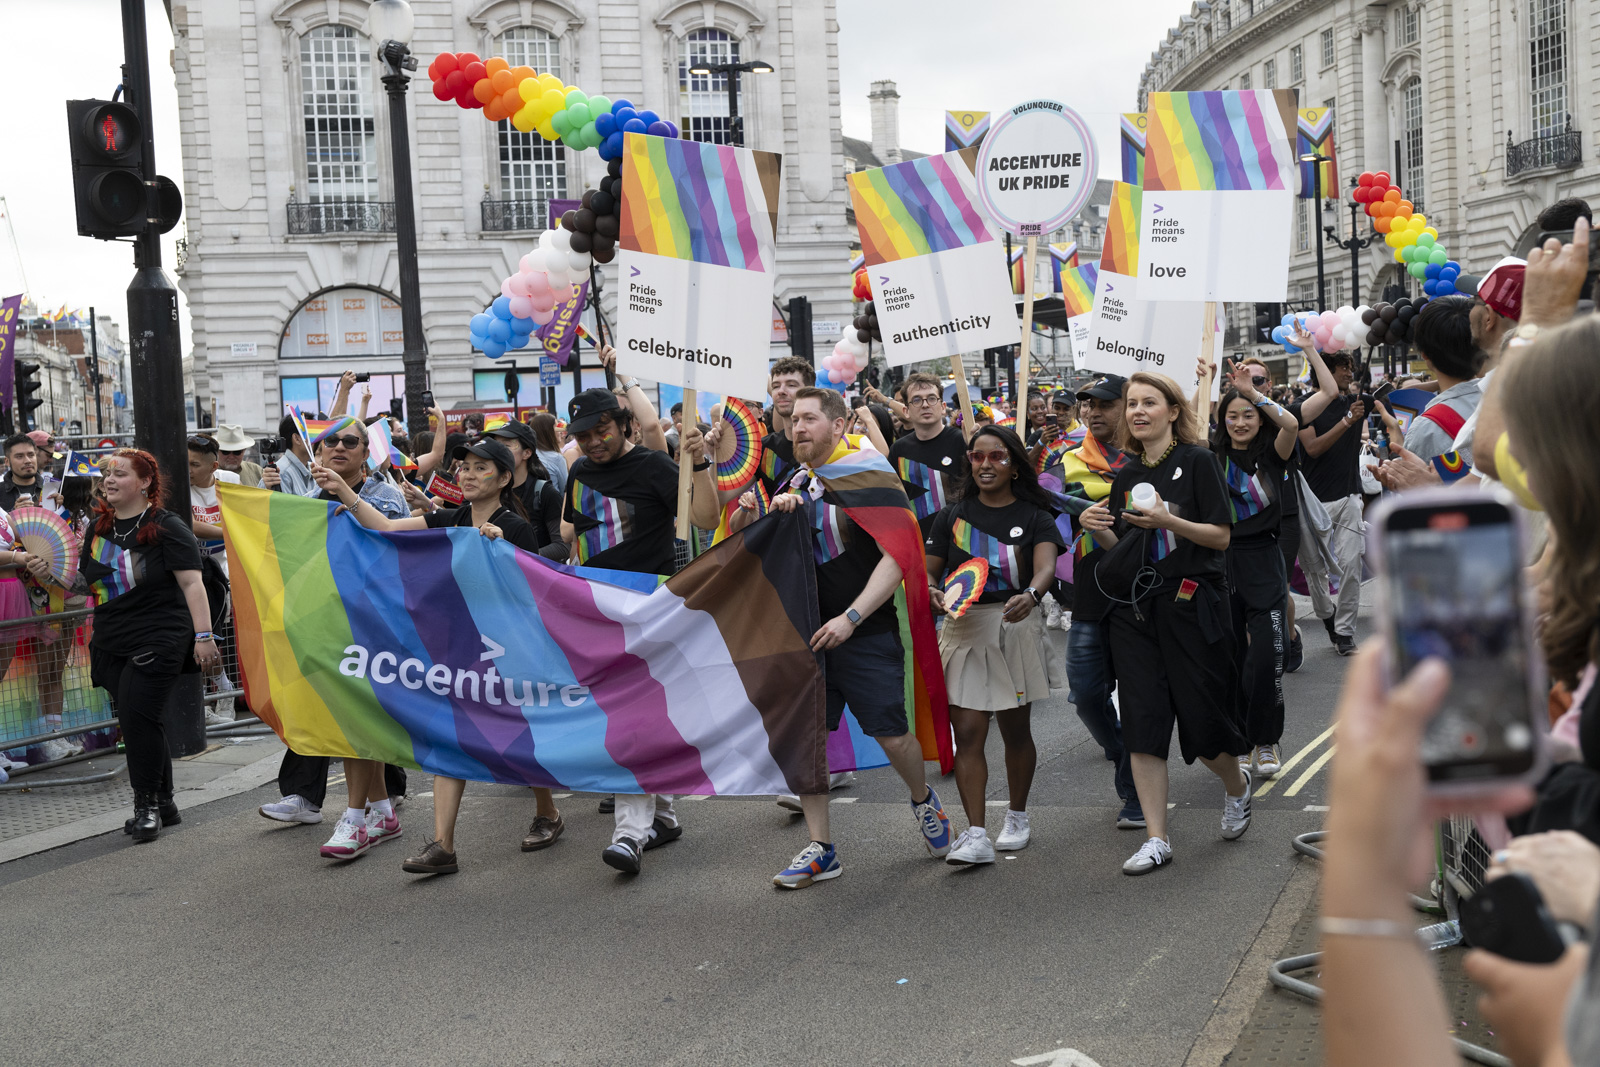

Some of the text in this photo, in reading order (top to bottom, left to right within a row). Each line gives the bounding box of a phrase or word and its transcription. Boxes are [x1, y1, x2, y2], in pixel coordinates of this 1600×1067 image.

[1012, 101, 1063, 116] VOLUNQUEER
[989, 152, 1082, 171] ACCENTURE
[998, 174, 1070, 191] UK PRIDE
[1152, 218, 1179, 226] Pride
[1149, 262, 1187, 278] love
[630, 283, 656, 296] Pride
[883, 286, 907, 298] Pride
[630, 294, 663, 306] means
[885, 293, 915, 304] means
[1103, 296, 1124, 308] Pride
[630, 303, 655, 314] more
[886, 302, 910, 312] more
[1102, 305, 1128, 316] means
[1101, 312, 1122, 322] more
[893, 315, 991, 344] authenticity
[628, 337, 732, 369] celebration
[1096, 337, 1165, 366] belonging
[446, 414, 462, 422] BUY
[1270, 610, 1284, 653] MASTER
[338, 644, 590, 707] accenture
